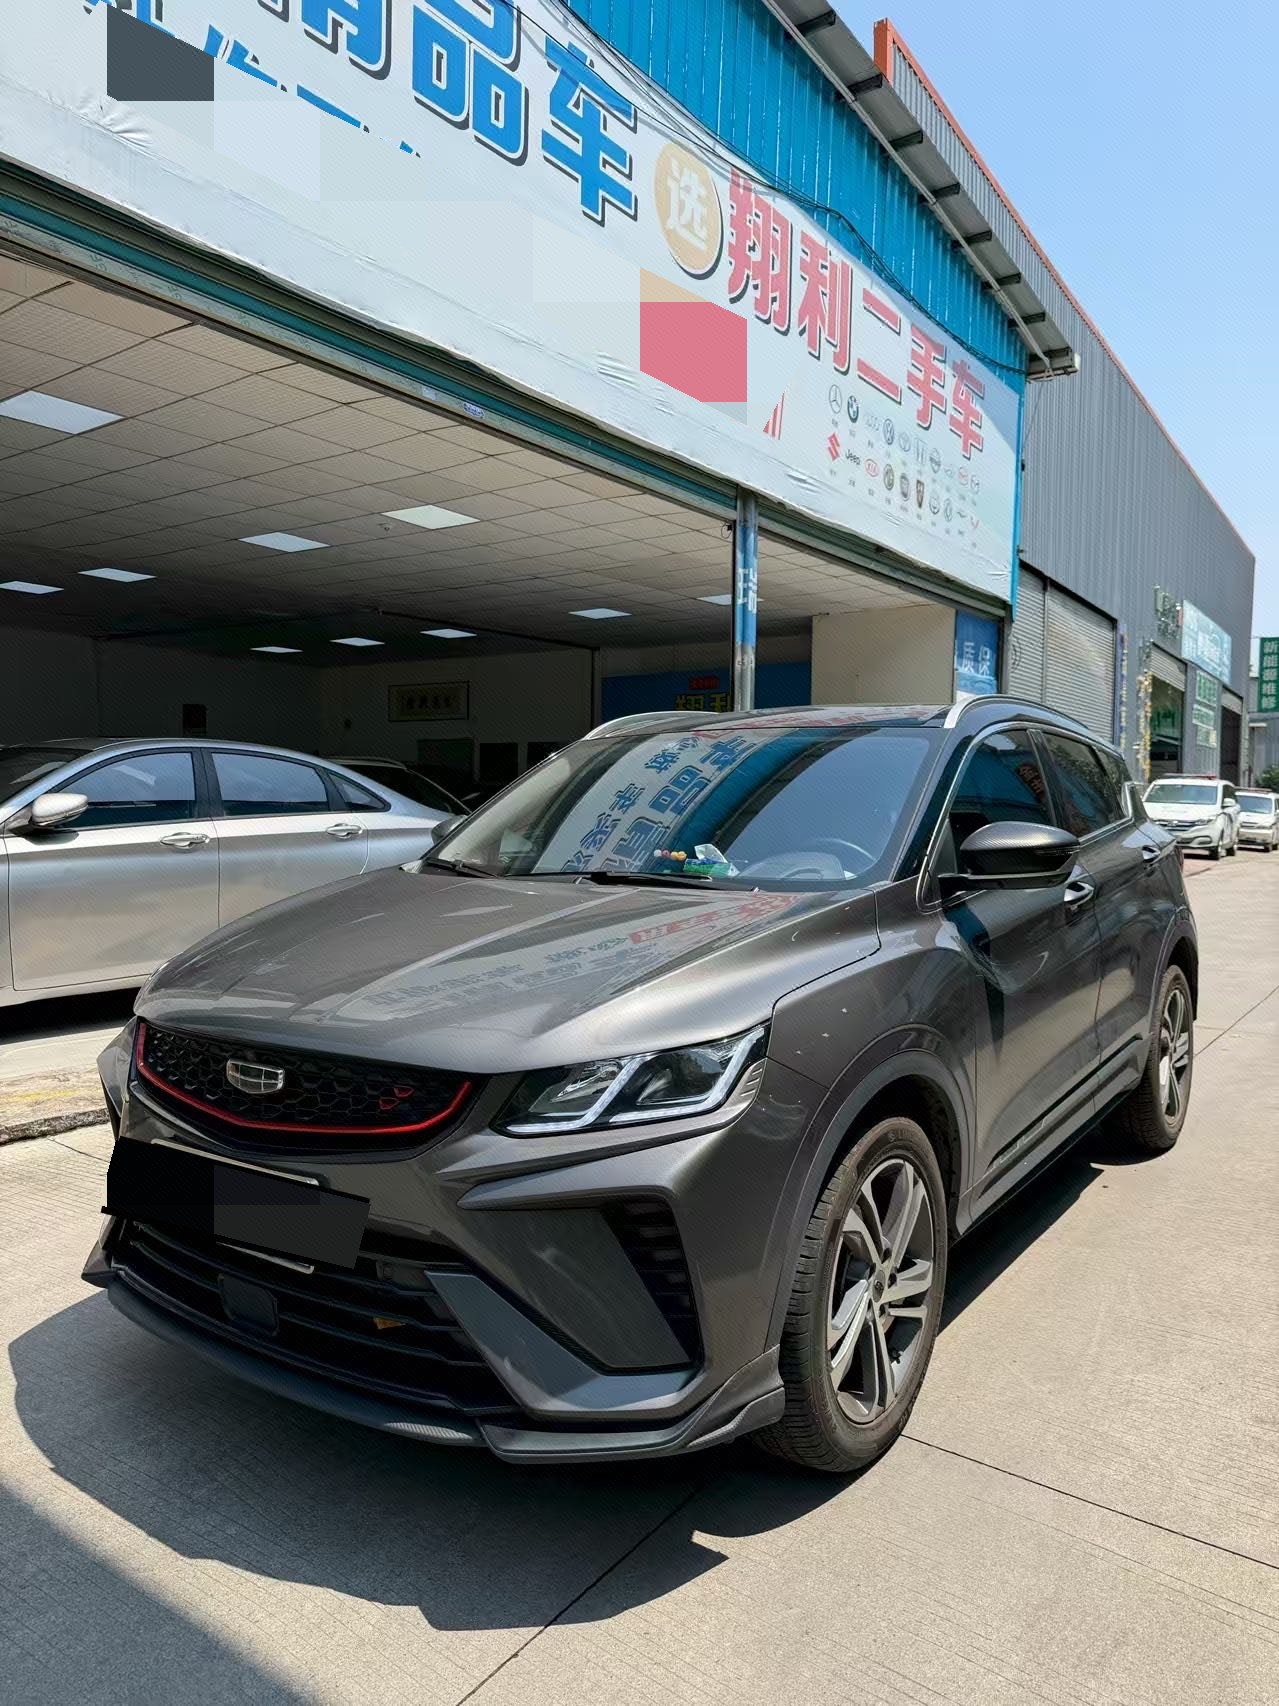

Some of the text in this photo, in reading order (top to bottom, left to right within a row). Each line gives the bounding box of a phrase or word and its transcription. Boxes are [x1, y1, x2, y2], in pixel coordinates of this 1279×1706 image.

[727, 167, 985, 459] 翔利二手车
